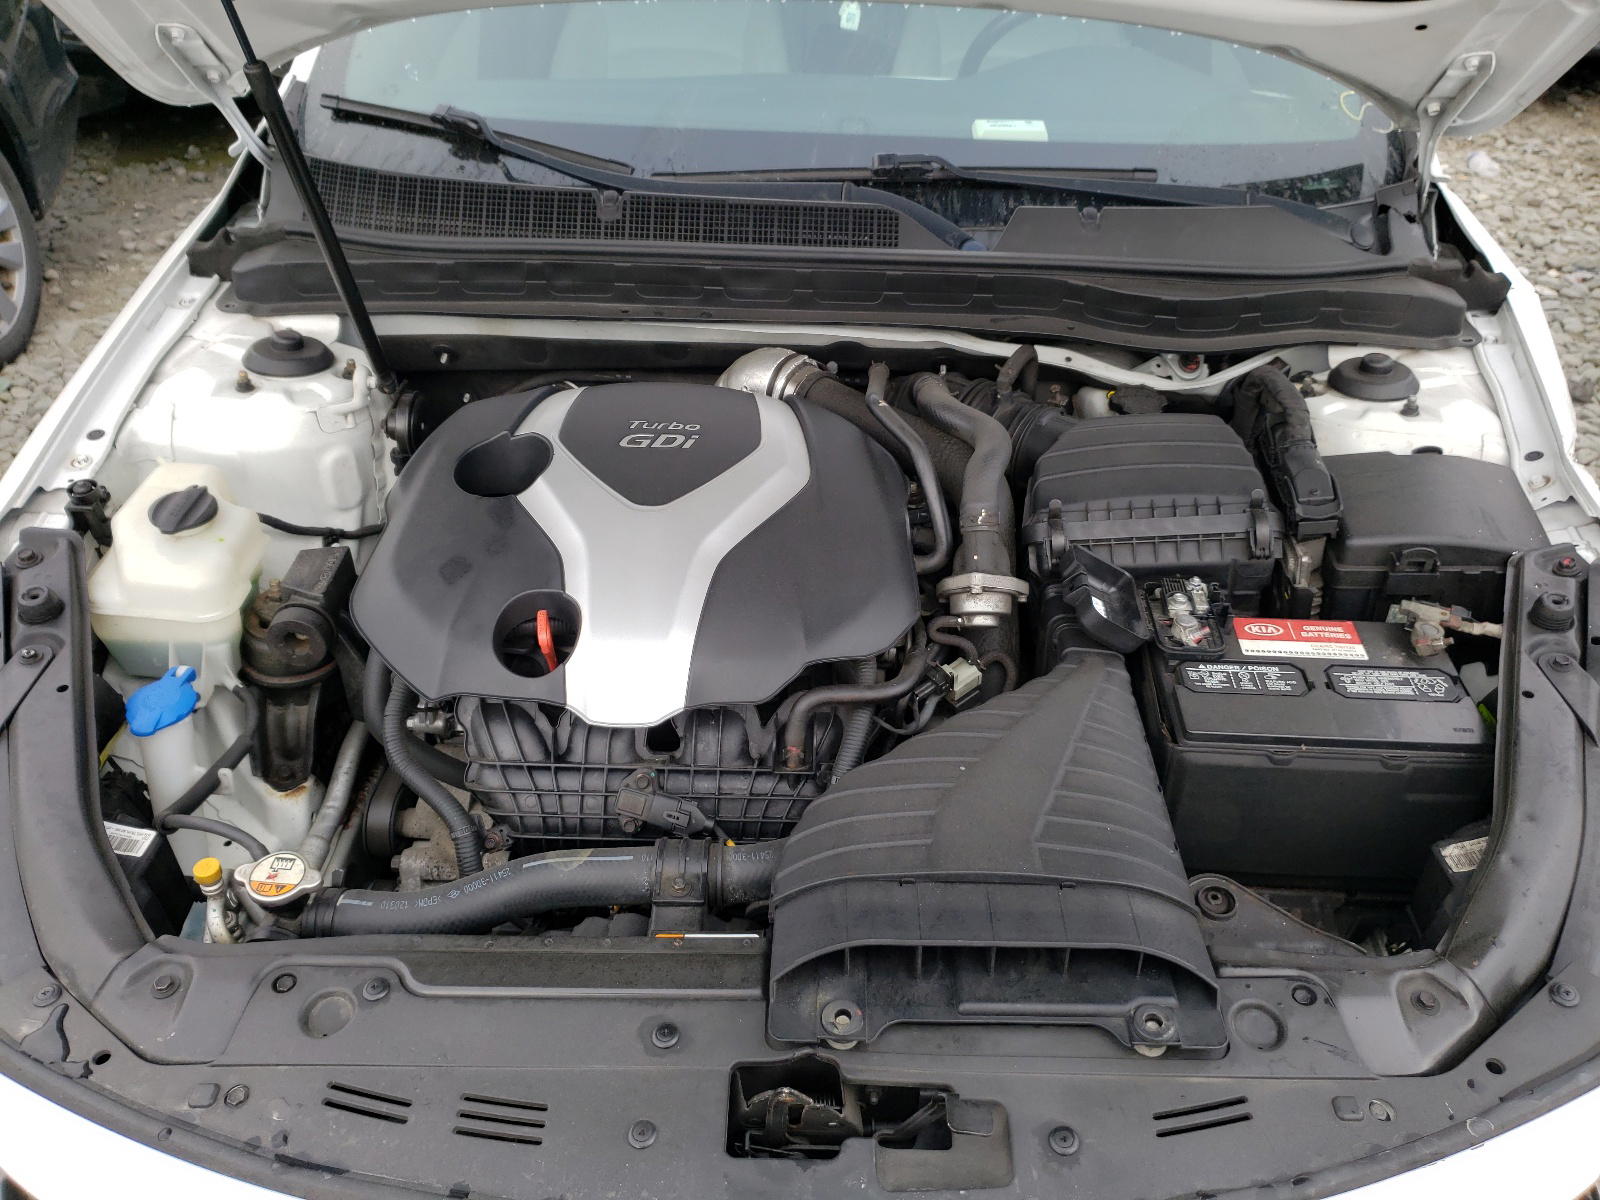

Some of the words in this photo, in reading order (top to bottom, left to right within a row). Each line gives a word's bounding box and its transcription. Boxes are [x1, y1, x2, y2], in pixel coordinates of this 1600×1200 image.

[628, 420, 701, 431] Turbo
[618, 433, 701, 449] GDi
[1302, 625, 1344, 633] GENUINE
[1300, 631, 1352, 640] BATTERIES
